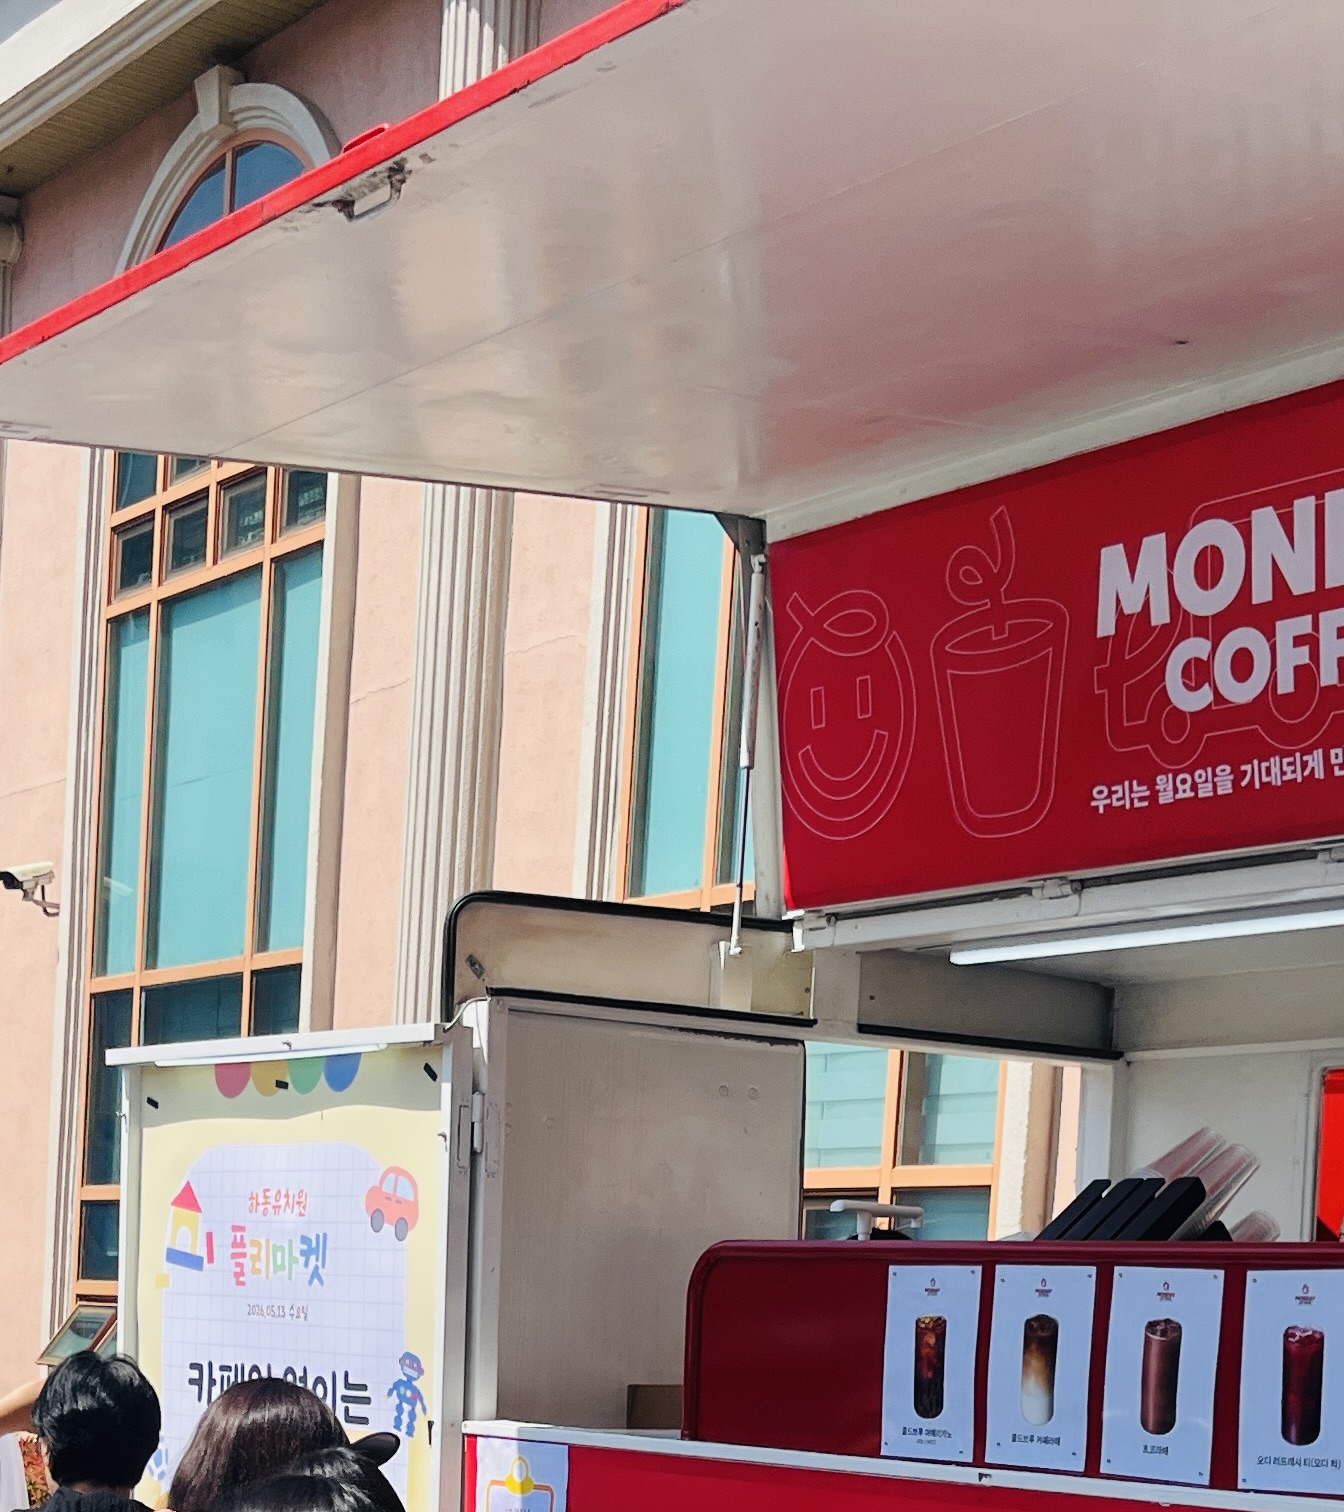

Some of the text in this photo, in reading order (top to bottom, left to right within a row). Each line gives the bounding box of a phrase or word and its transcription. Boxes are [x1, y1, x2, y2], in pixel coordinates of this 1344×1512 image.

[1090, 781, 1150, 814] 우리는
[1155, 763, 1234, 803] 월요일을
[1240, 750, 1325, 789] 기대되게
[247, 1187, 309, 1219] 하동유치원
[230, 1223, 328, 1288] 플리마켓
[289, 1303, 309, 1322] 수요일
[1257, 1455, 1272, 1466] 오디
